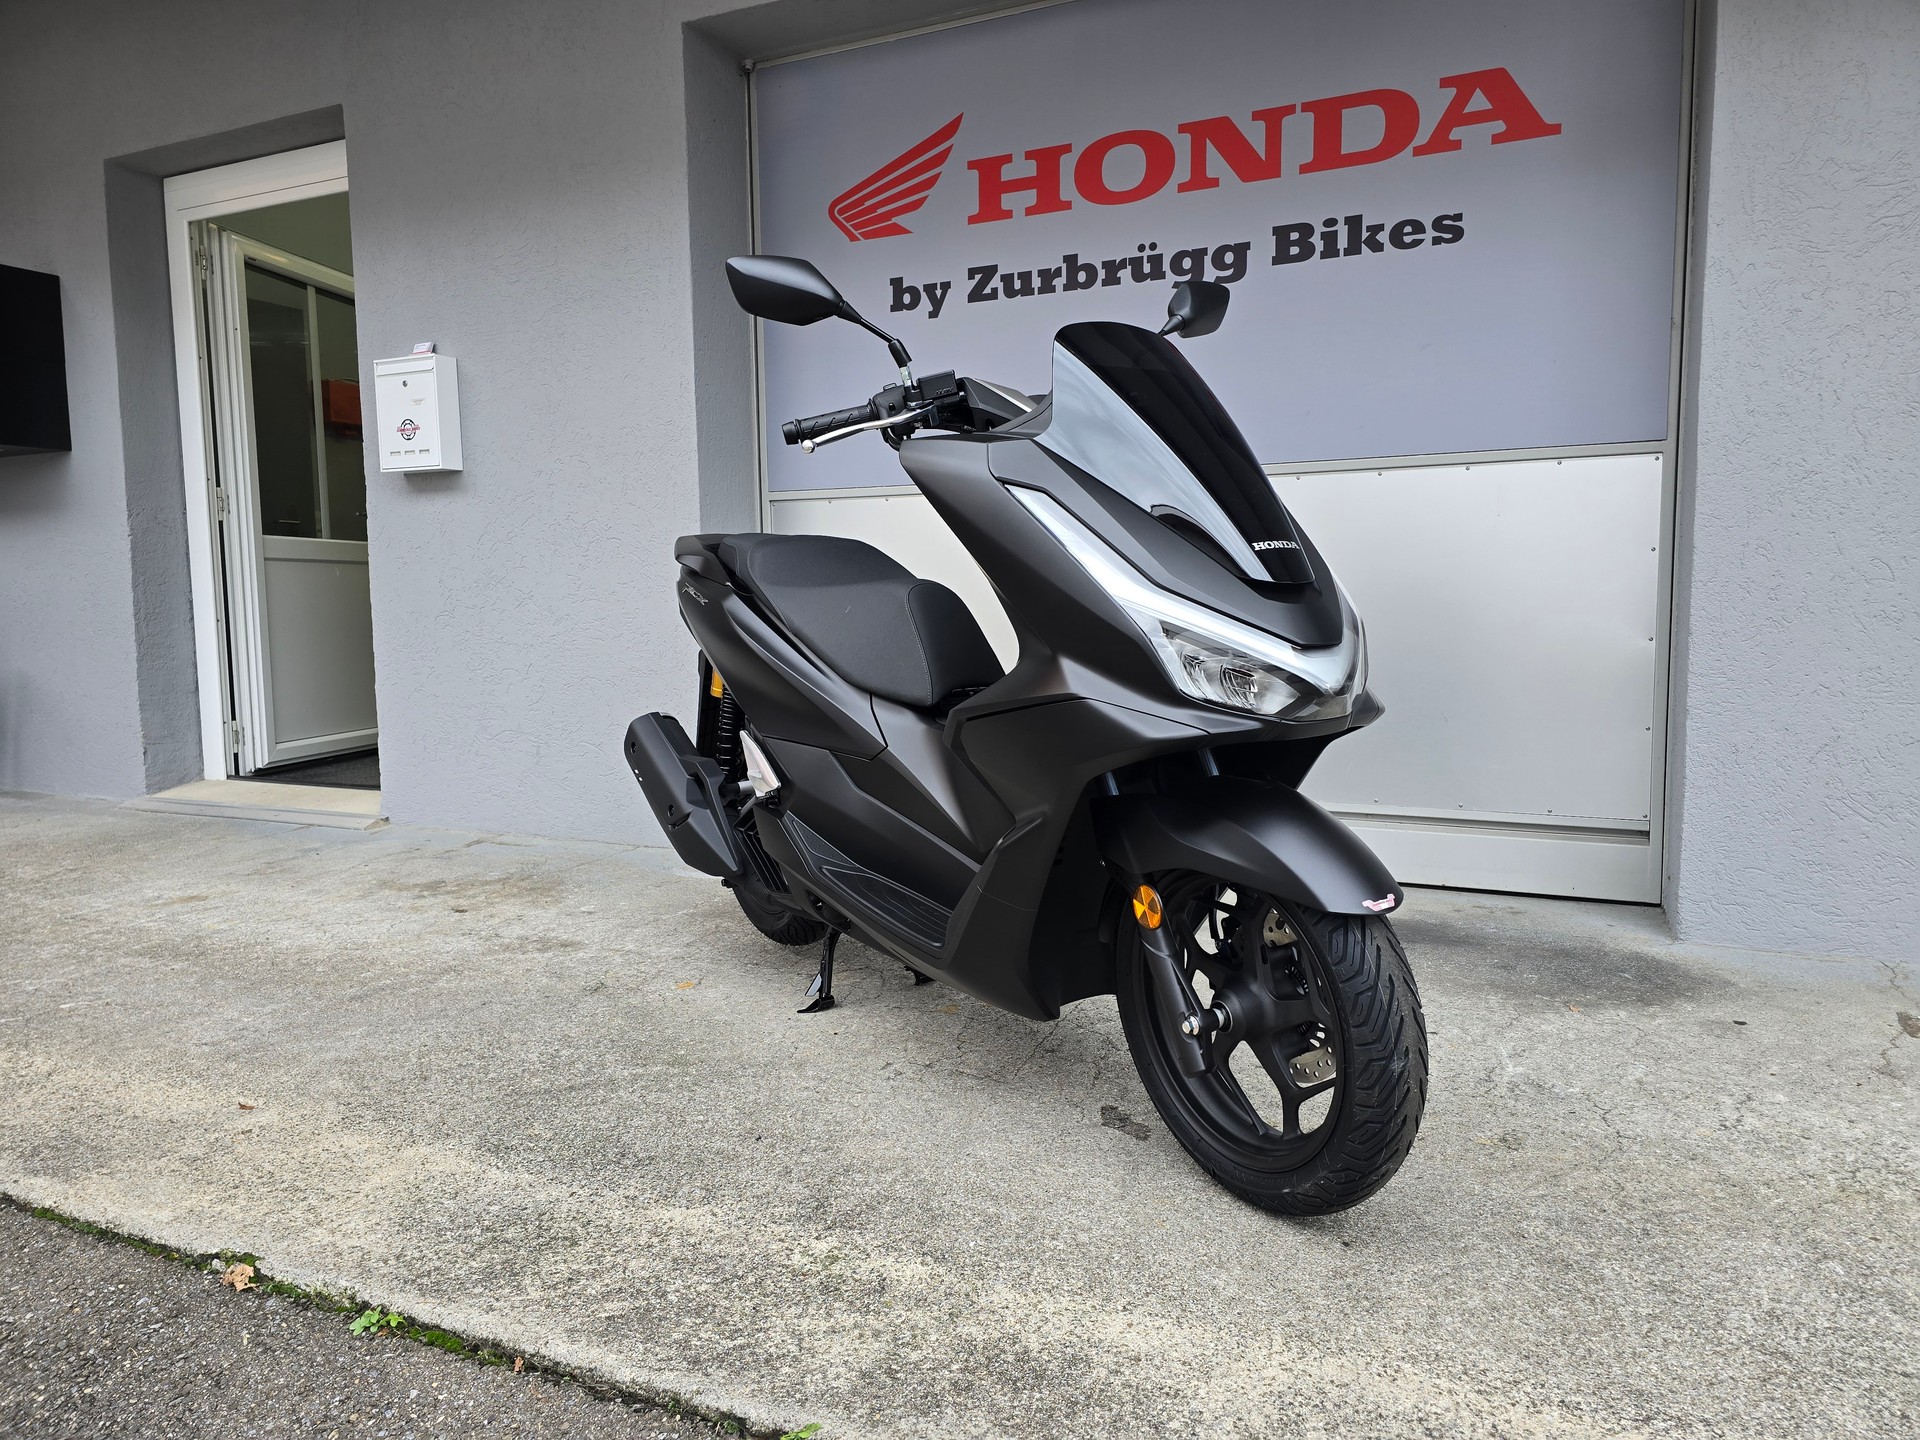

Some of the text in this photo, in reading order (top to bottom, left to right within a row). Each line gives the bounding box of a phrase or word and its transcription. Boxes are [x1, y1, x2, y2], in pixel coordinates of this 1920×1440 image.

[967, 67, 1562, 226] HONDA
[889, 212, 1465, 320] by Zurbrügg Bikes
[1251, 540, 1301, 551] HONDA
